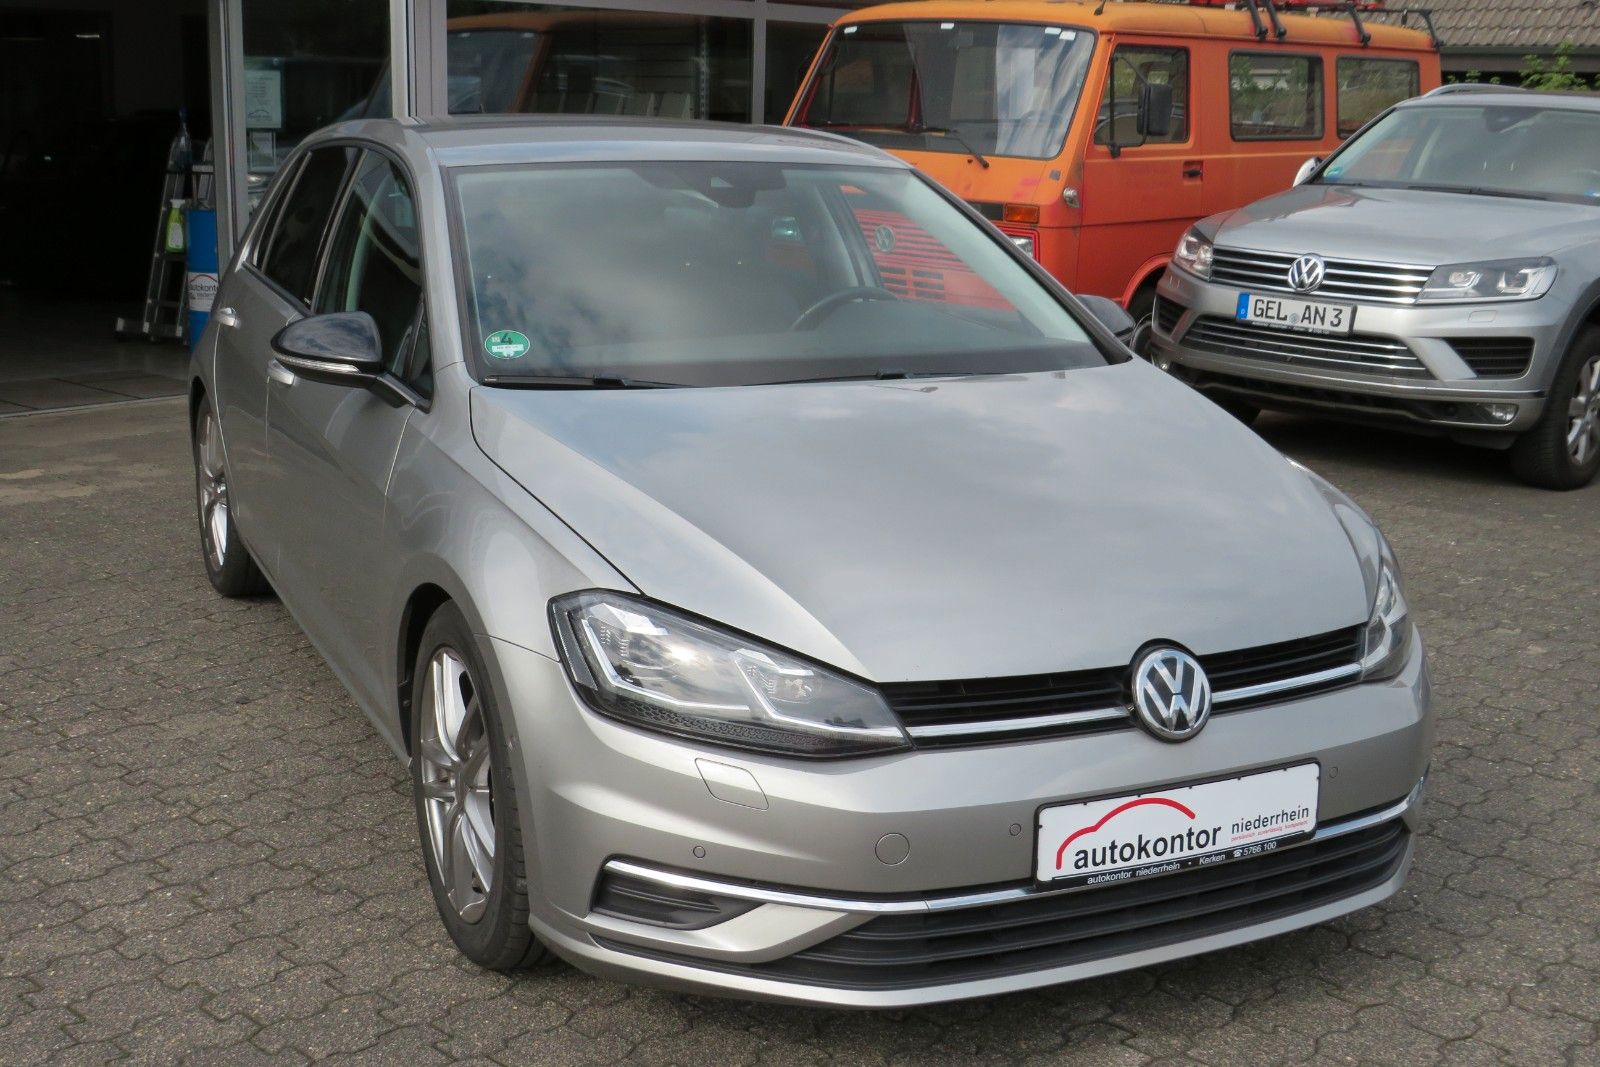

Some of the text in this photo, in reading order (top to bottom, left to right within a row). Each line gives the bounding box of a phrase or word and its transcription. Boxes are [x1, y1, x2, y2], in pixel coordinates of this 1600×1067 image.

[1253, 298, 1343, 327] GEL AN 3
[500, 332, 513, 345] 4
[1231, 805, 1310, 835] niederrhein
[1074, 825, 1222, 870] autokontor
[1087, 869, 1132, 885] autokontor
[1135, 861, 1181, 877] niederrhein
[1199, 852, 1226, 865] Kerken
[1263, 841, 1278, 853] 100
